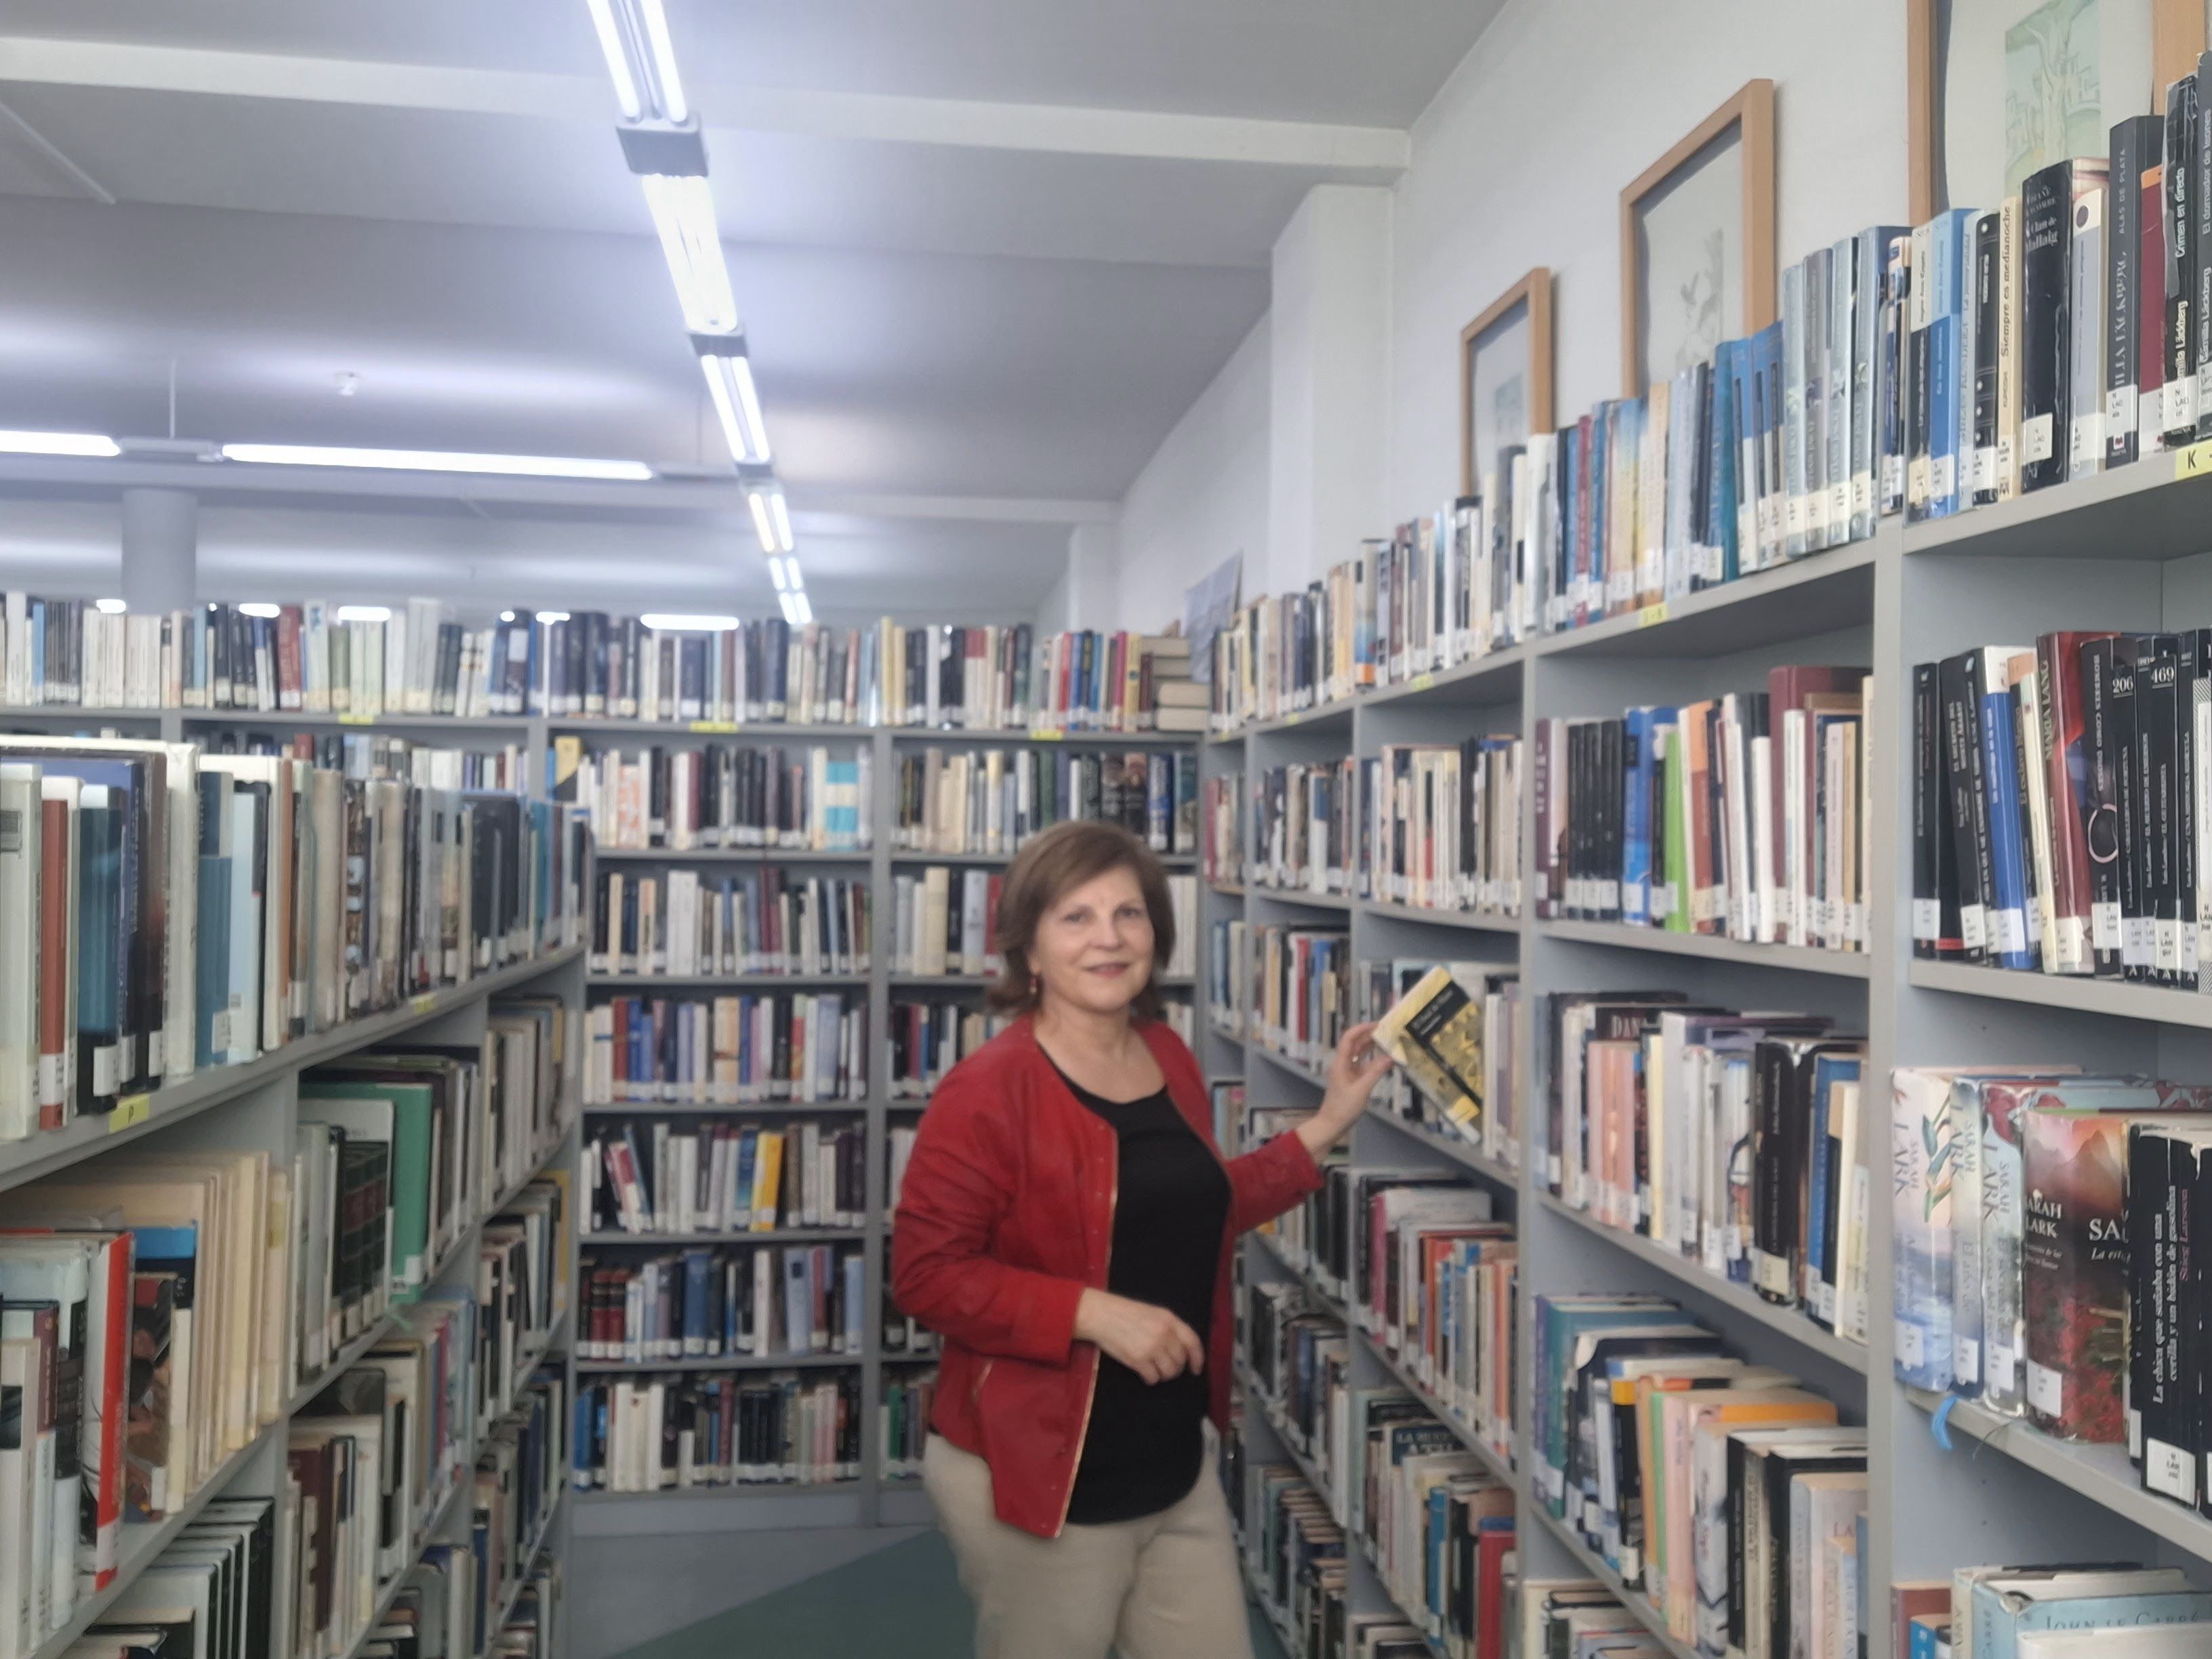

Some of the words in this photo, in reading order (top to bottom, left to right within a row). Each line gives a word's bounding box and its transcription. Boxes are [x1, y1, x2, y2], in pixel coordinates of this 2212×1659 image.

[2203, 150, 2211, 165] de
[2119, 187, 2125, 203] DE
[2177, 204, 2185, 218] en
[2002, 205, 2011, 282] medianoche
[2175, 220, 2186, 258] Crimen
[2003, 285, 2010, 300] es
[2001, 304, 2010, 358] Siempre
[2187, 449, 2197, 470] K
[2112, 676, 2134, 694] 206
[2151, 666, 2175, 684] 469
[1893, 1122, 1910, 1199] LARK
[1982, 1143, 1999, 1224] LARK
[2026, 1197, 2062, 1220] ARAH
[2154, 1318, 2166, 1345] que
[2152, 1347, 2164, 1383] chica
[2152, 1386, 2164, 1405] La
